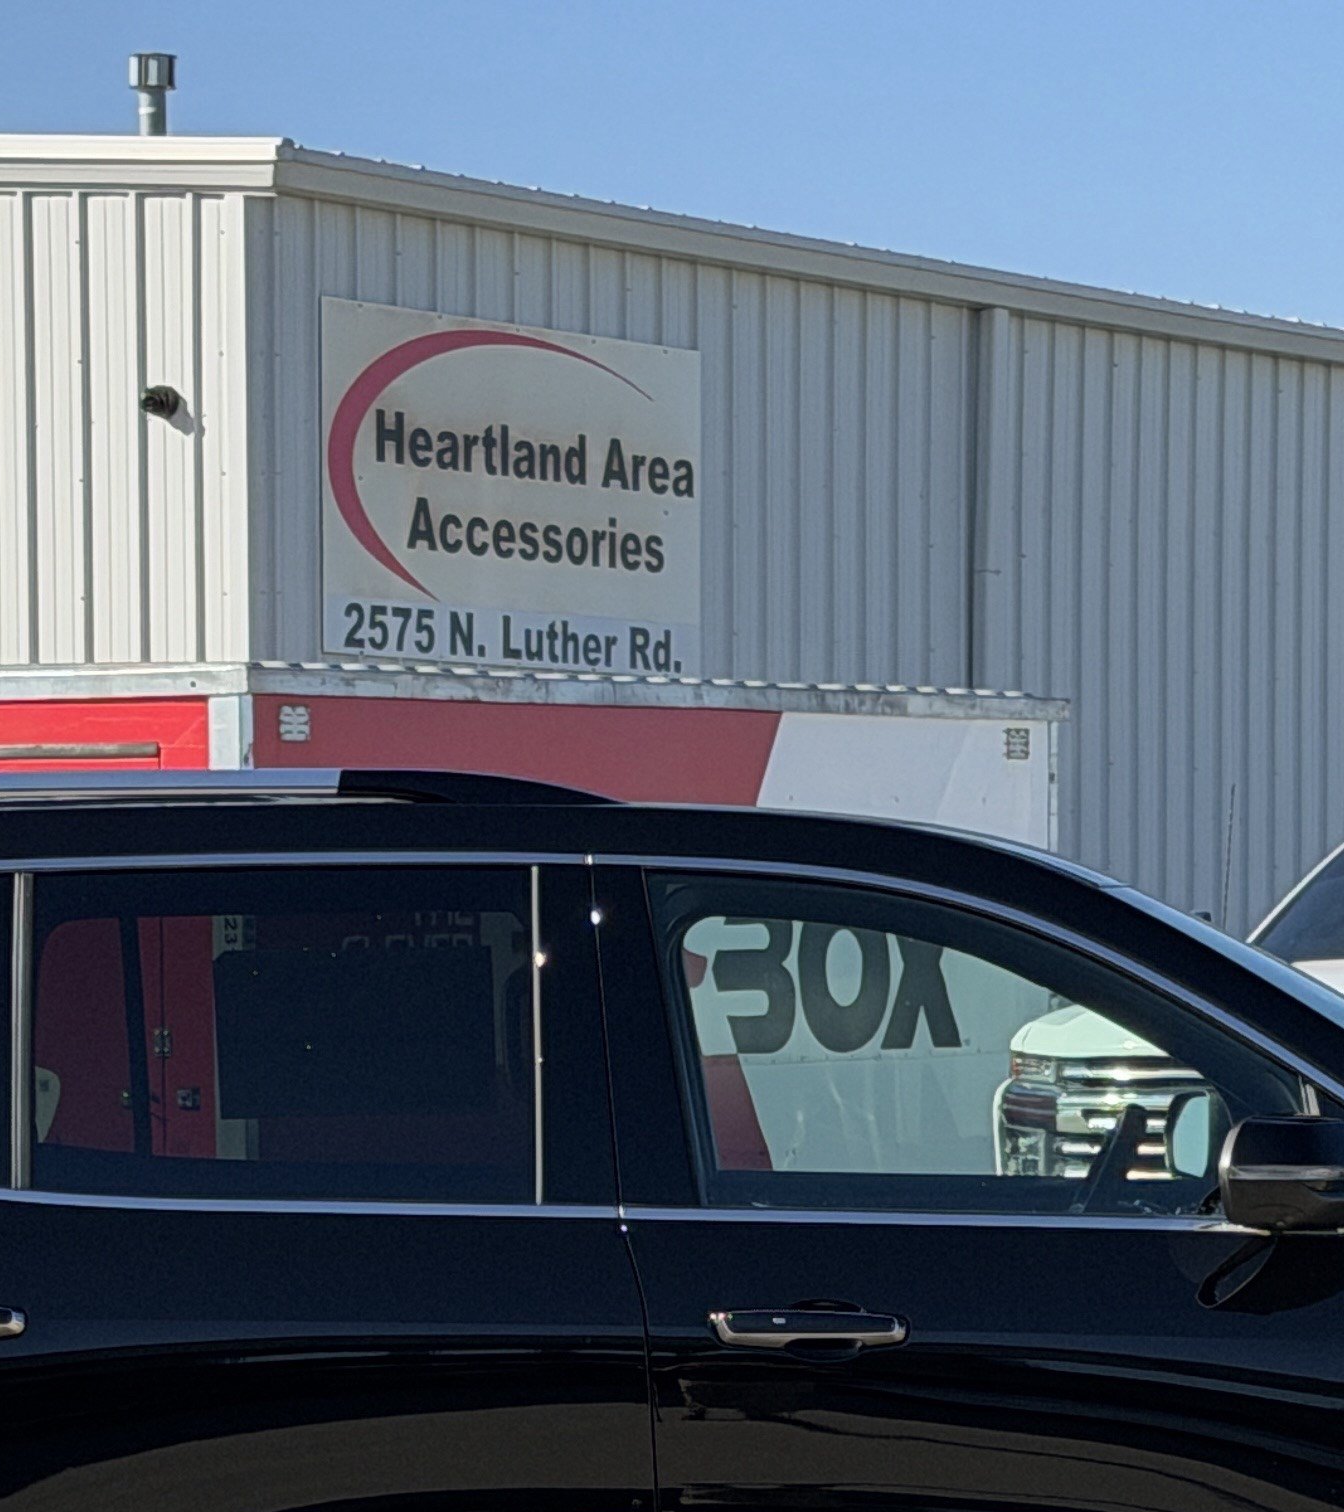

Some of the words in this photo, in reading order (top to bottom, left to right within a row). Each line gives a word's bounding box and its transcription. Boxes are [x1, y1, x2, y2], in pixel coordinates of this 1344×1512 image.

[374, 408, 586, 486] Heartland
[601, 438, 694, 498] Area
[406, 496, 665, 574] Accessories
[343, 601, 436, 655] 2575
[449, 611, 486, 659] N.
[501, 615, 618, 668] Luther
[628, 626, 682, 674] Rd.
